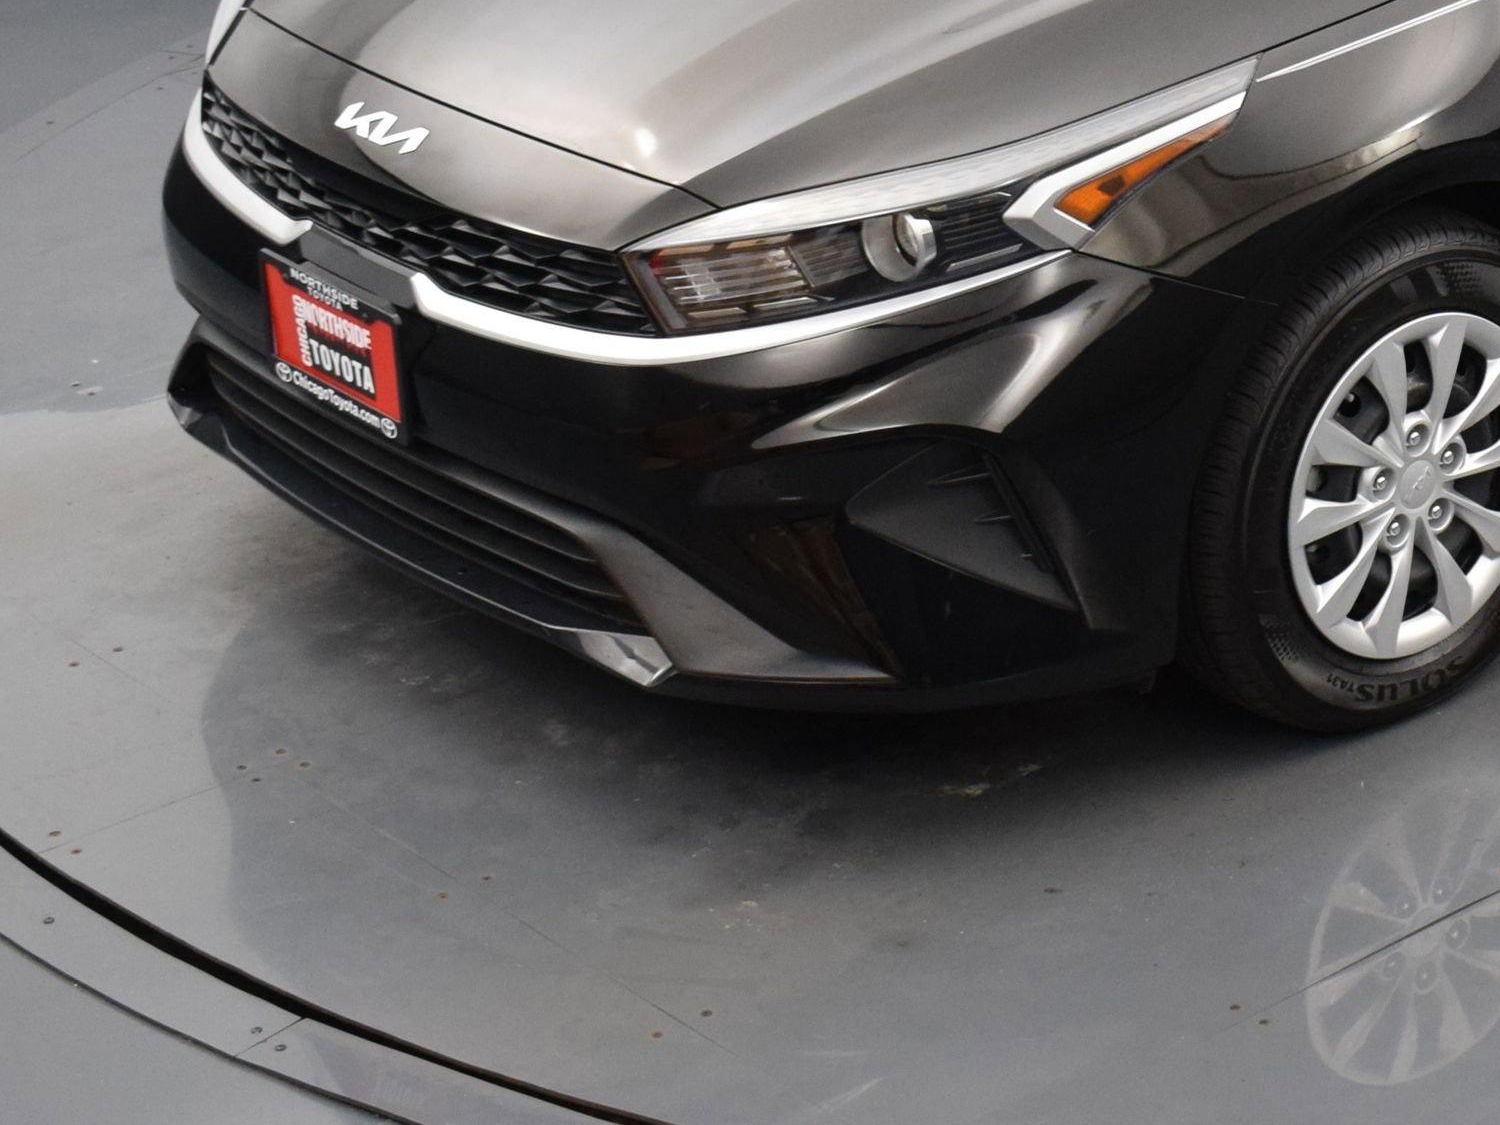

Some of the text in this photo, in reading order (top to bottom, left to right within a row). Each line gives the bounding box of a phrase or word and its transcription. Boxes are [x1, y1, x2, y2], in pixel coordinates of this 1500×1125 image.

[289, 267, 359, 310] NORTHSIDE
[307, 286, 343, 312] TOYOTA
[291, 293, 313, 367] CHICAGO
[309, 338, 375, 395] TOYOTA
[293, 371, 382, 429] ChicagoToyota.com
